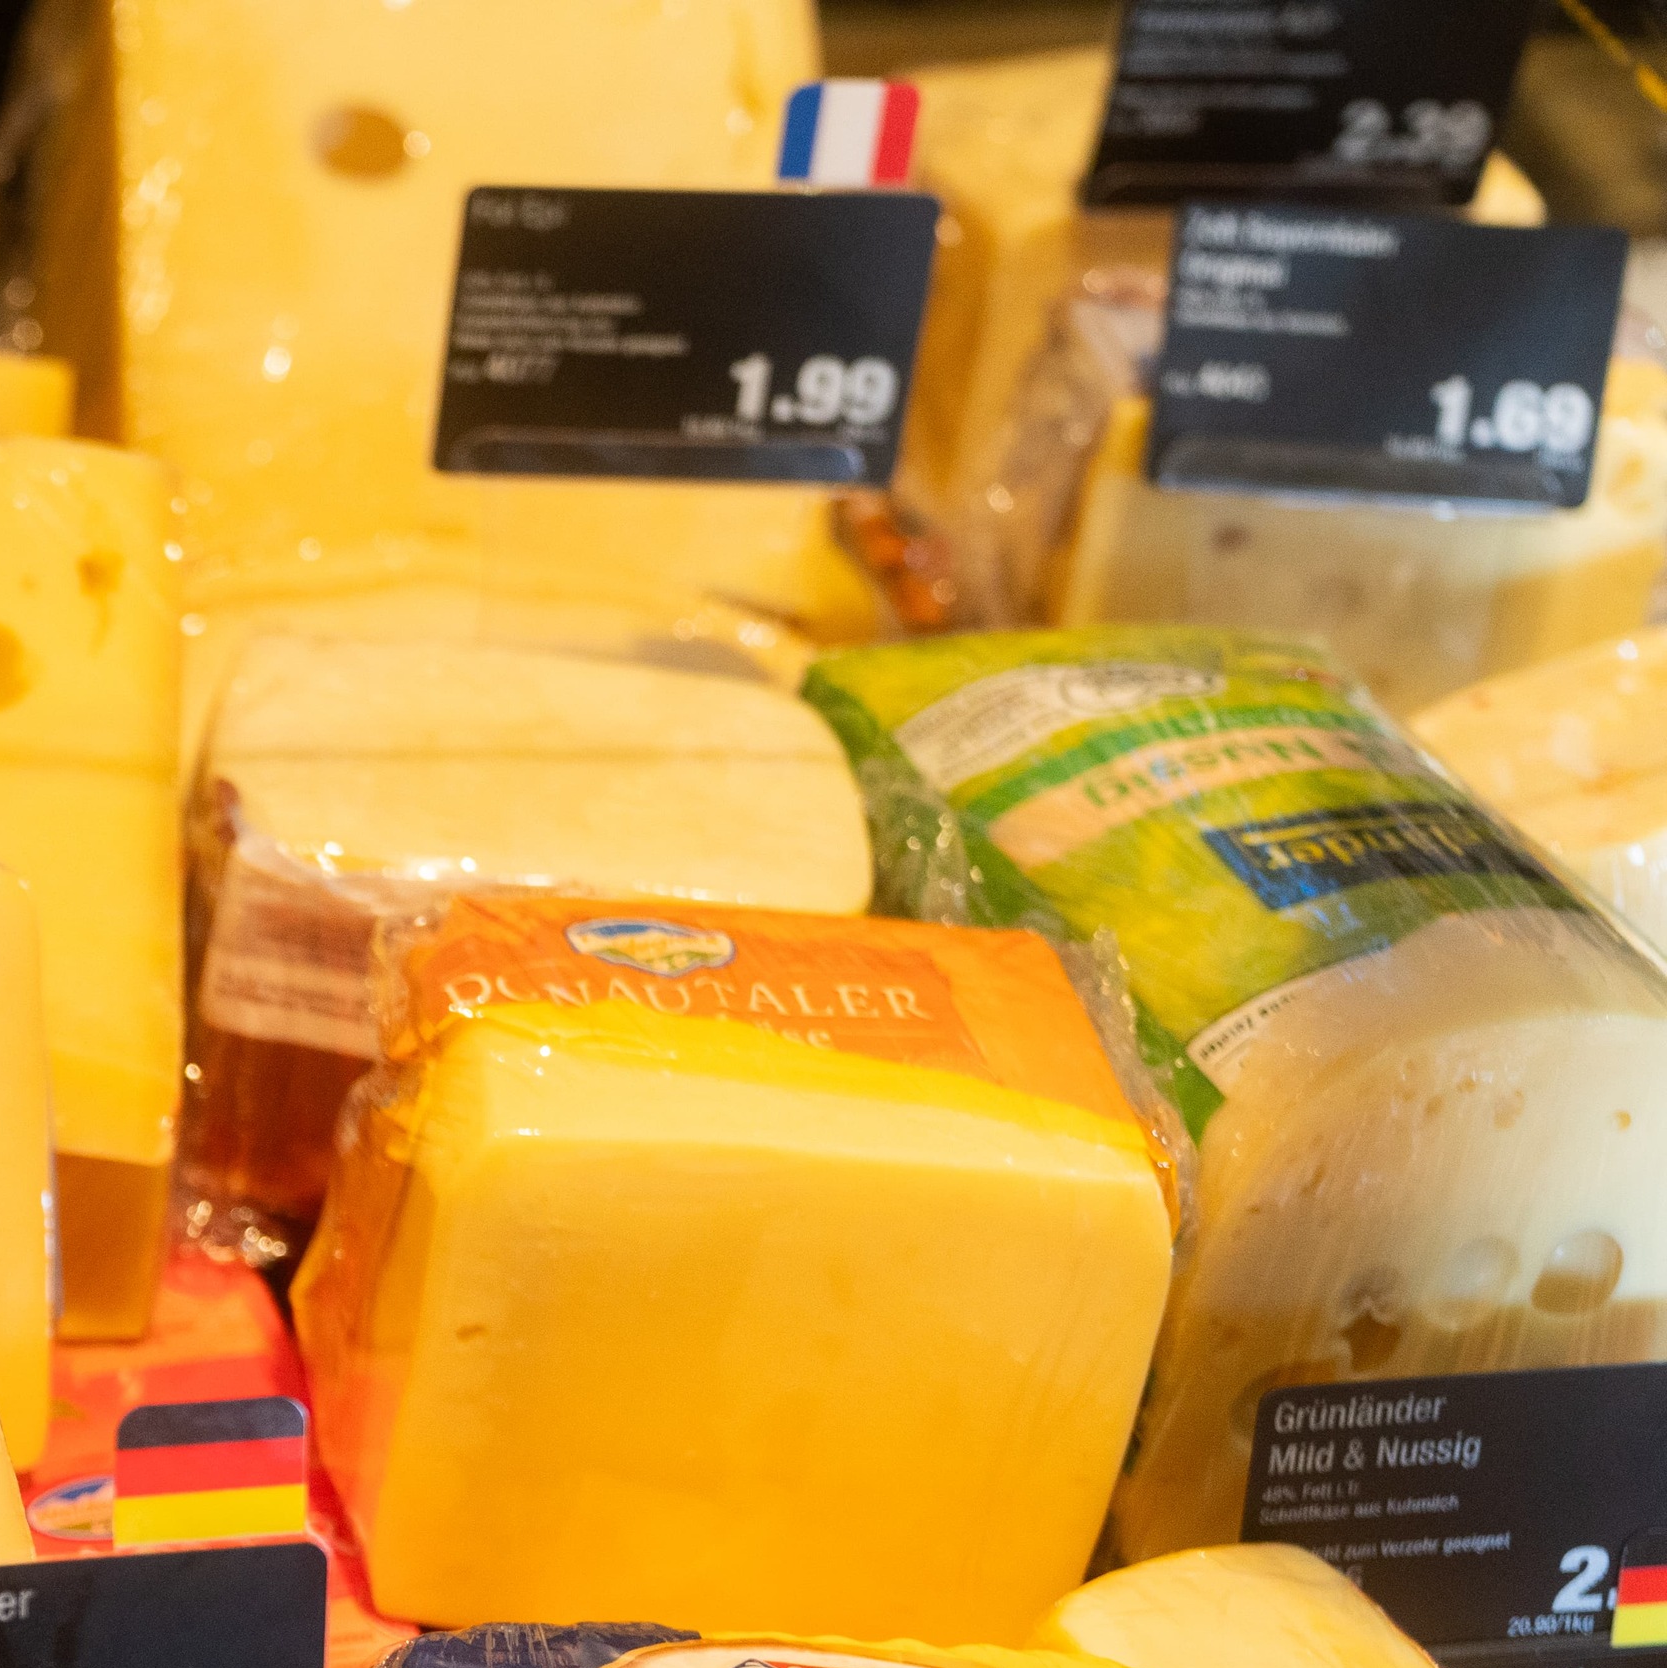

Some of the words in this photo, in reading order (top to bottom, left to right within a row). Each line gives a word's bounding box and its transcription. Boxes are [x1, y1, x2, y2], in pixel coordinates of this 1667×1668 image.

[730, 351, 899, 425] 1.99
[1429, 374, 1596, 454] 1.69
[1274, 1391, 1446, 1434] Grünländer
[1268, 1441, 1335, 1476] Mild
[1343, 1438, 1367, 1470] &
[1376, 1430, 1482, 1470] Nussig
